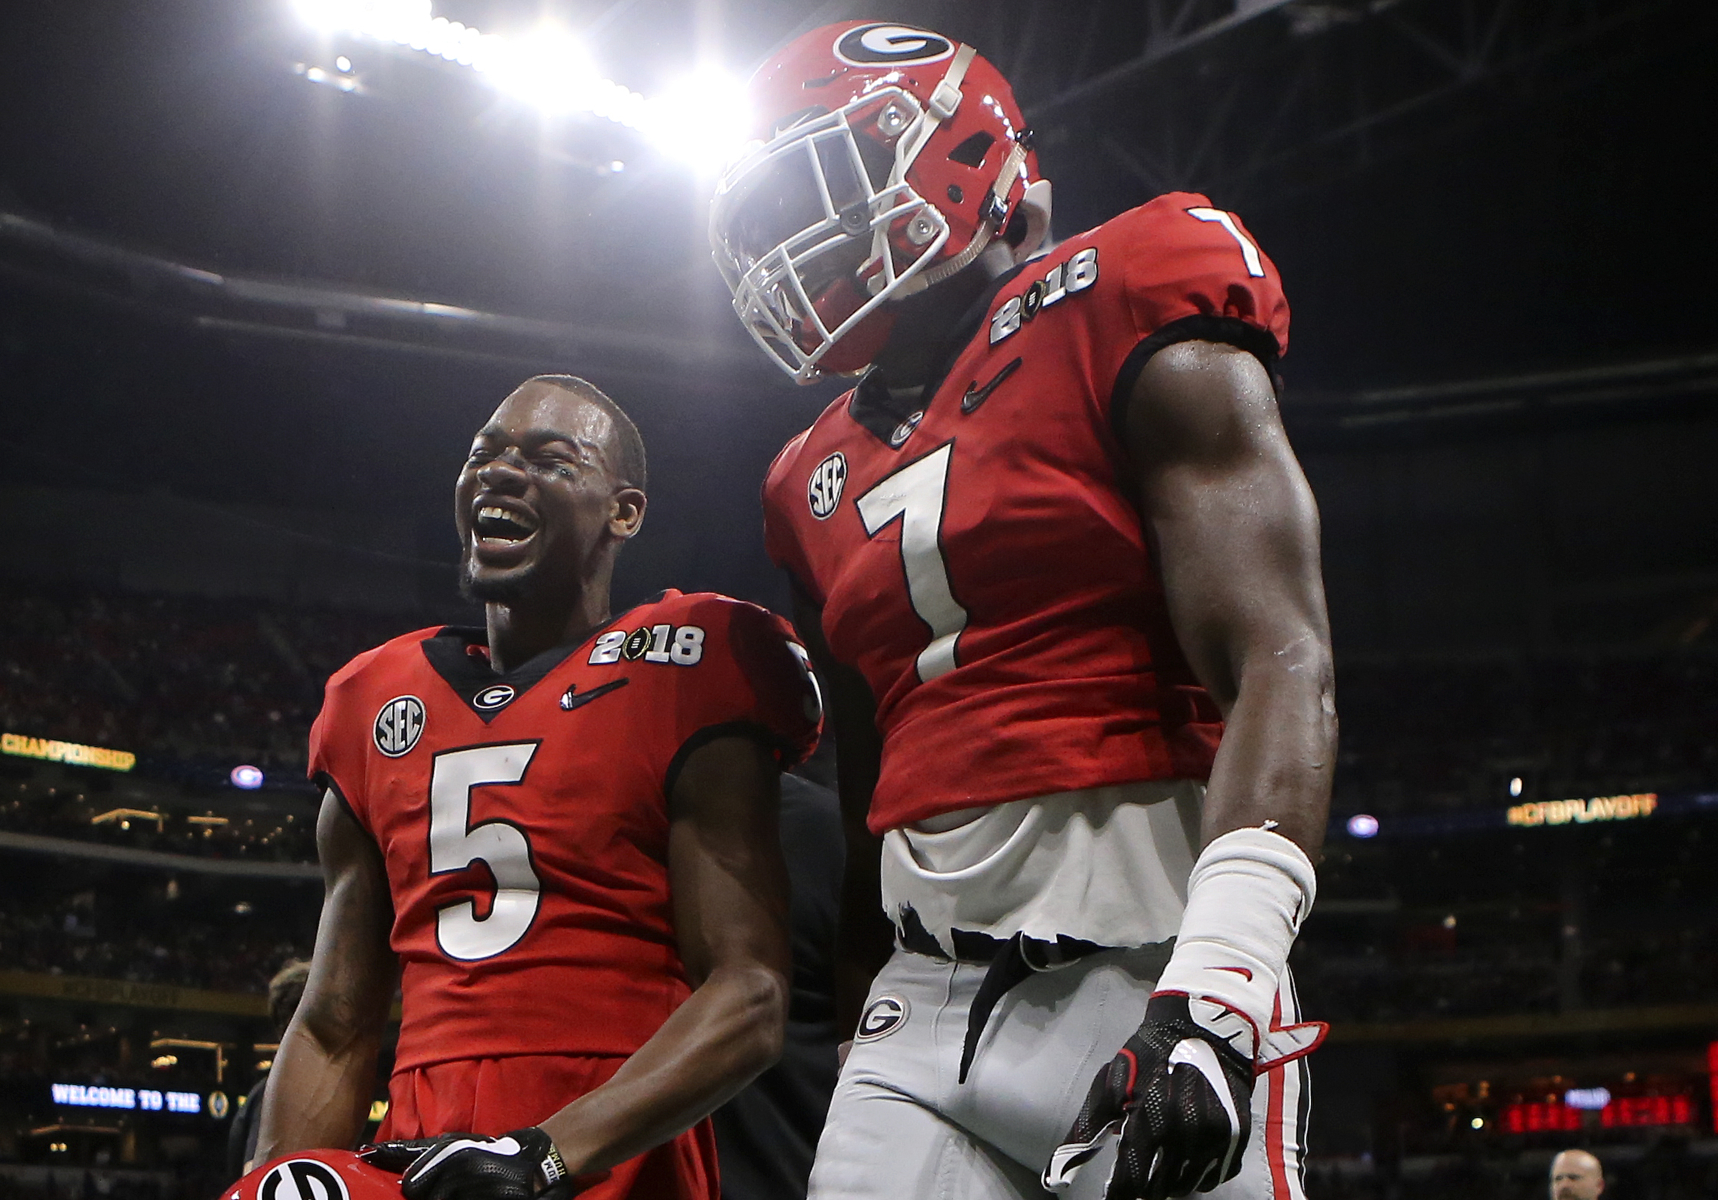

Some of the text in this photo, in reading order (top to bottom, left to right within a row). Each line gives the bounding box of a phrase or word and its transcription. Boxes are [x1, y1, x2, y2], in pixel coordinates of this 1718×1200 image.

[834, 23, 953, 67] G
[1186, 206, 1267, 278] 7
[989, 247, 1099, 345] 2018
[810, 454, 846, 518] SEC
[854, 438, 967, 685] 7
[588, 624, 705, 666] 2018
[474, 686, 515, 708] G
[377, 698, 423, 754] SEC
[1, 733, 136, 771] CHAMPIONSHIP
[429, 739, 543, 962] 5
[859, 998, 903, 1037] G
[52, 1083, 200, 1113] WELCOME TO THE
